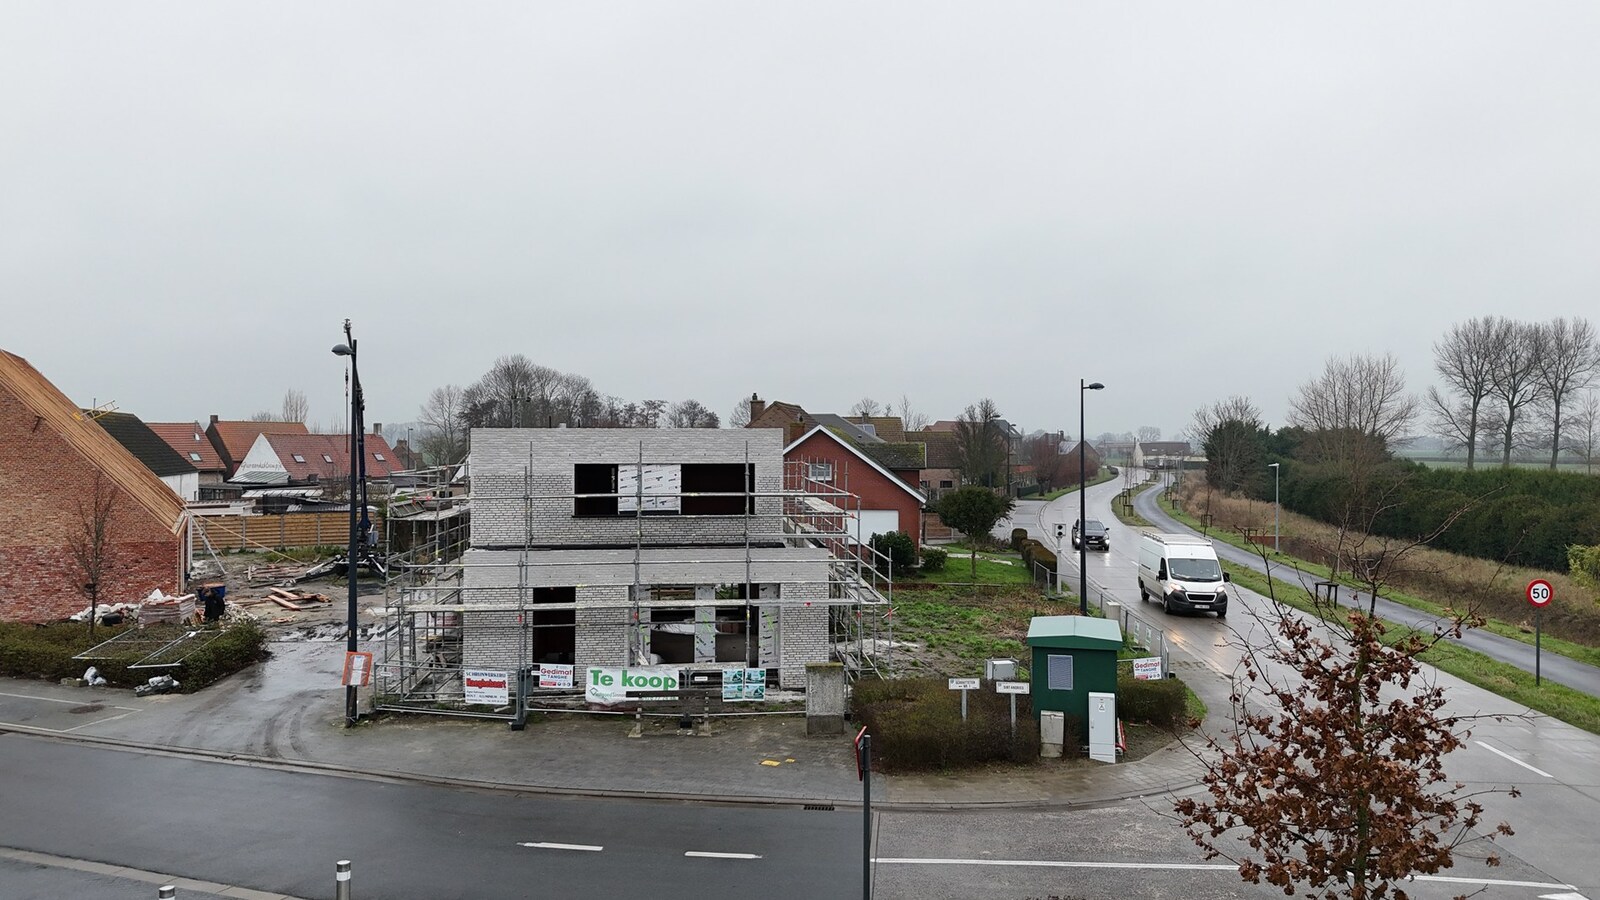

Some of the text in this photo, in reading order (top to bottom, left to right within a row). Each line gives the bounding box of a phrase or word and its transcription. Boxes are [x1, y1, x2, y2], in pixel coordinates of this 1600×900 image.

[1532, 588, 1549, 599] 50
[590, 669, 677, 690] Te koop
